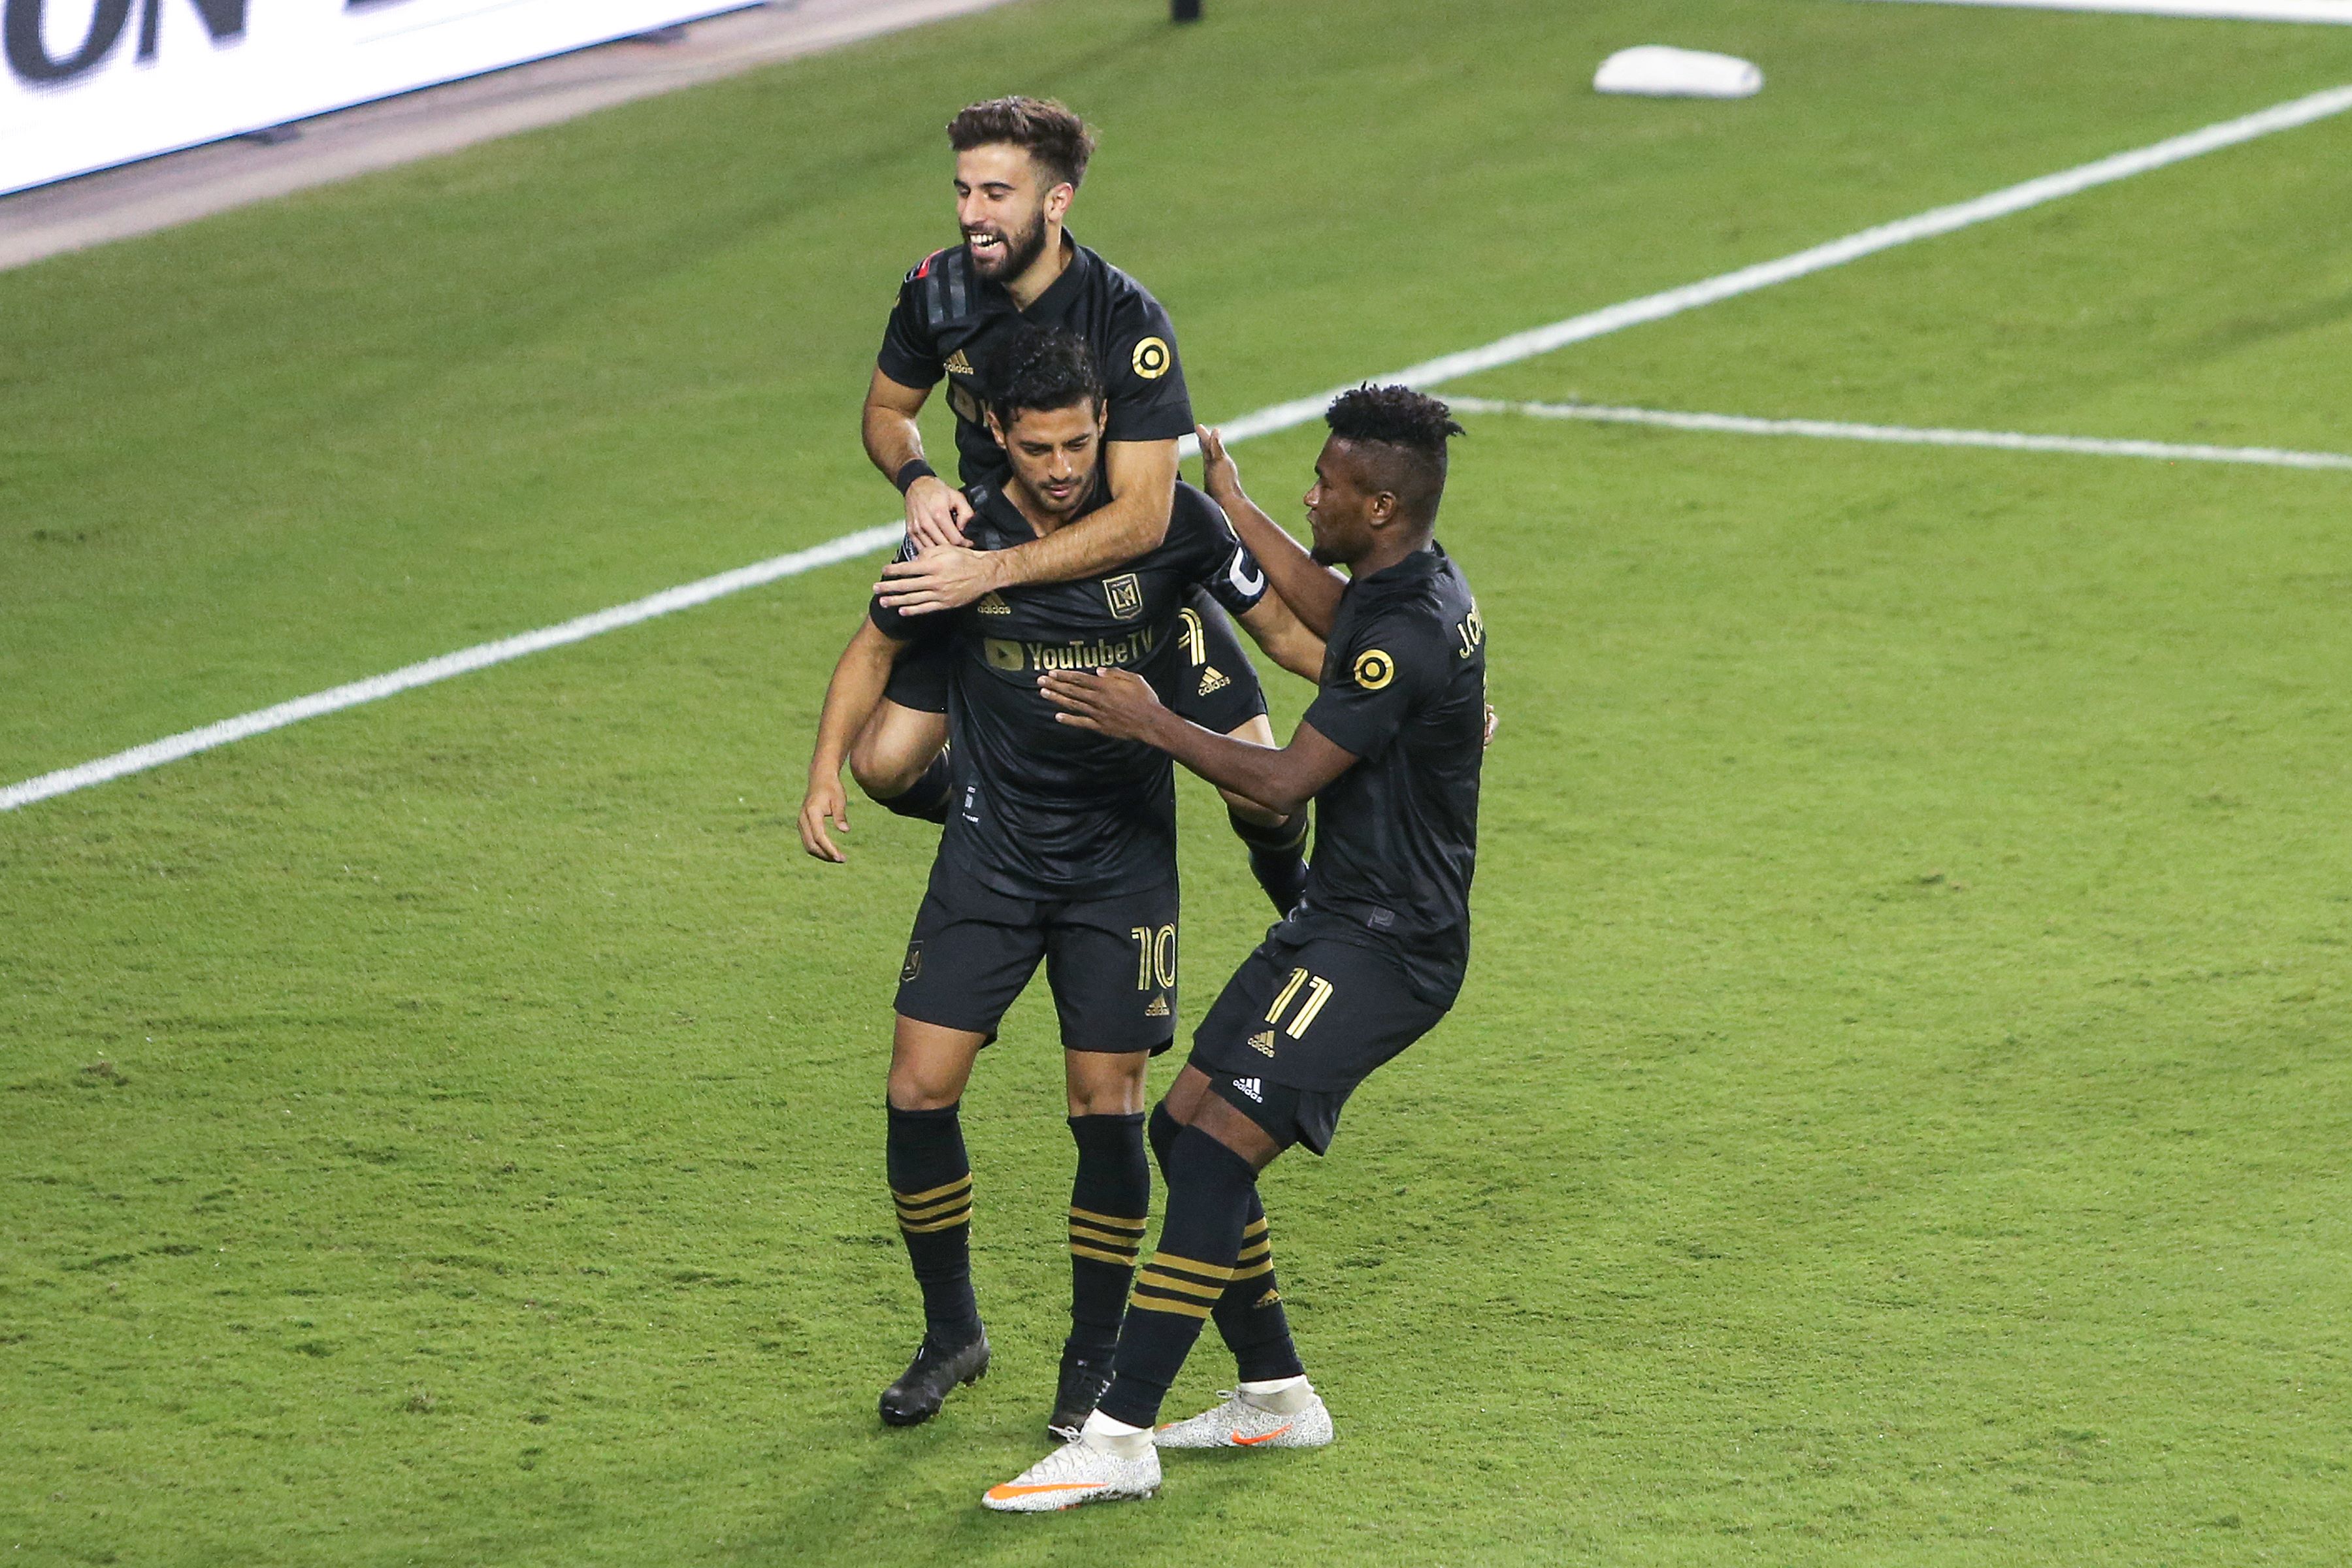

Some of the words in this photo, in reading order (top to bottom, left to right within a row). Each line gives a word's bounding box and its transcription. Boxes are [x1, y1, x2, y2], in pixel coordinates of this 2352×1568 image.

[943, 362, 973, 375] adidas
[977, 605, 1011, 614] adidas
[1026, 638, 1129, 671] YouTube
[1127, 625, 1154, 660] TV
[1198, 676, 1231, 696] adidas
[1131, 923, 1176, 990] 10
[1145, 1006, 1170, 1017] adidas
[1264, 967, 1335, 1040] 11
[1247, 1037, 1275, 1058] adidas
[1232, 1079, 1264, 1103] adidas
